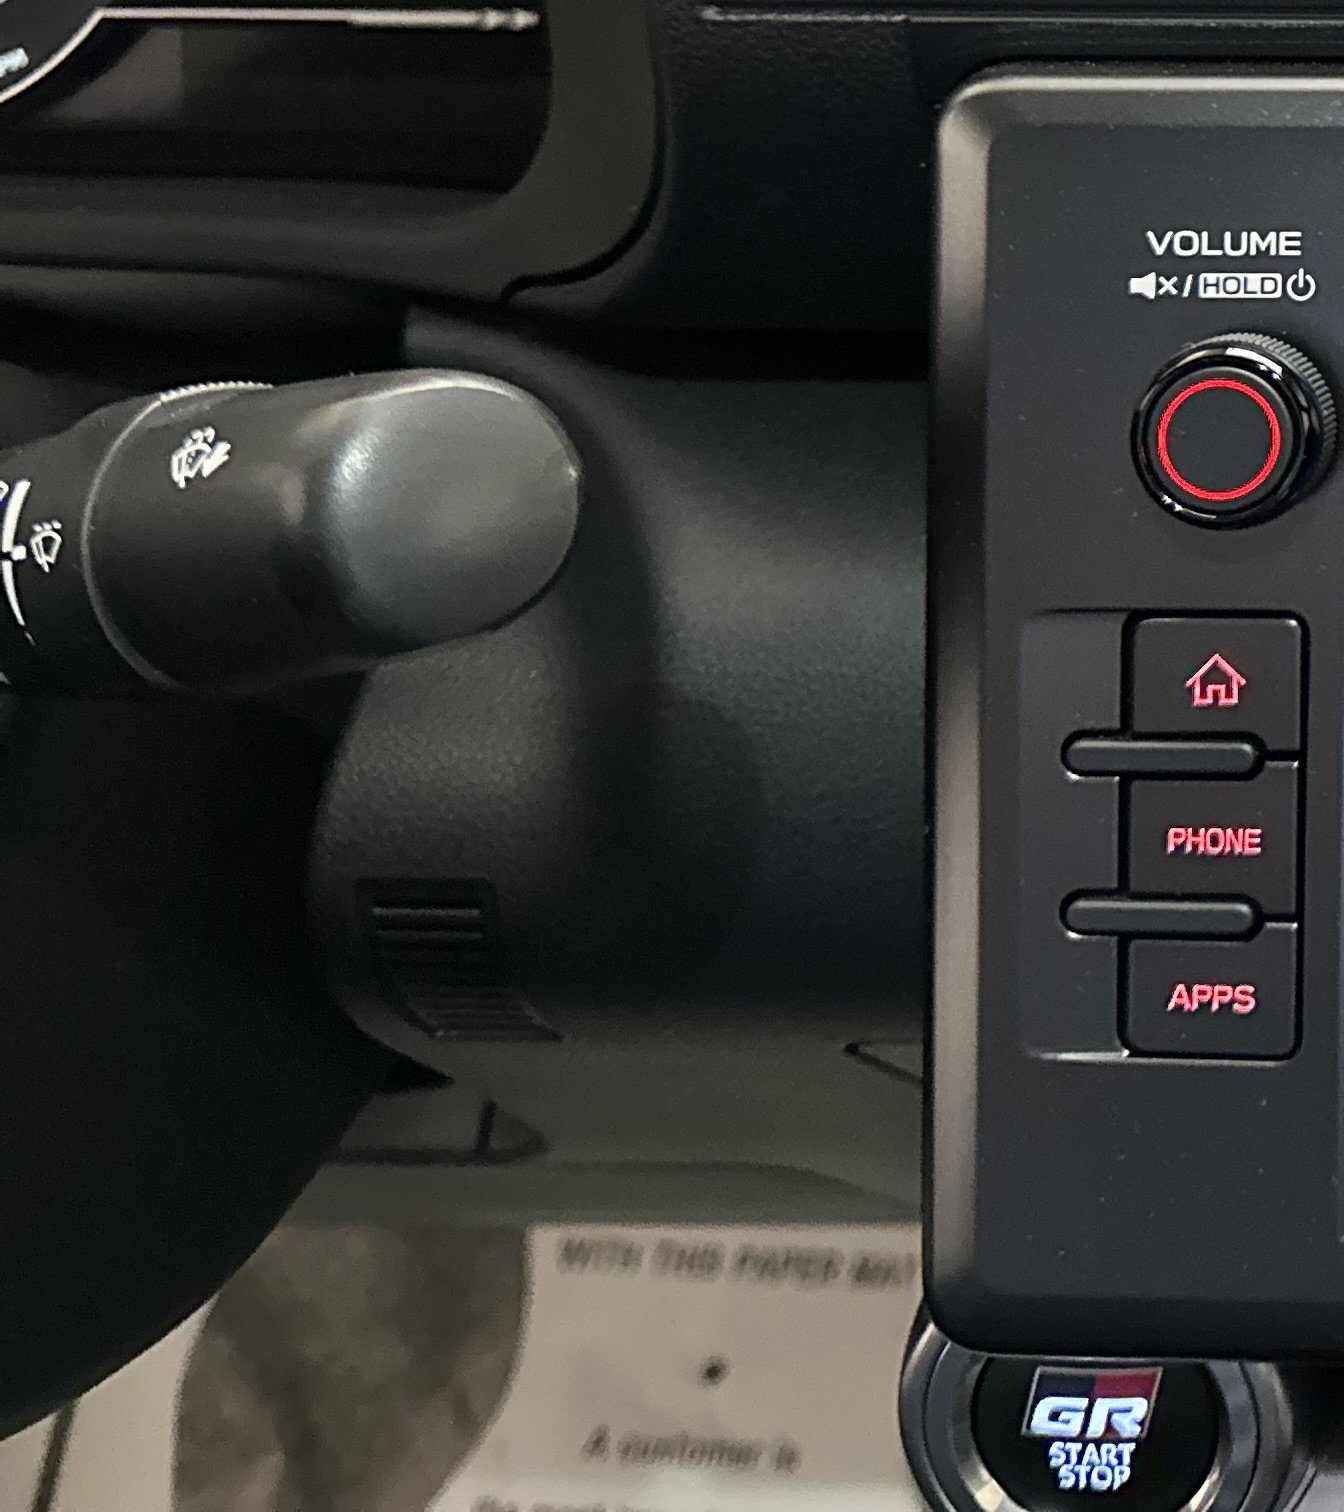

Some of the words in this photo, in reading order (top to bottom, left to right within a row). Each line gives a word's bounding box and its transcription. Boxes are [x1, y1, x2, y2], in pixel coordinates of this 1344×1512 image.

[1146, 230, 1303, 257] VOLUME
[1202, 275, 1280, 296] HOLD
[1167, 826, 1262, 856] PHONE
[1167, 983, 1256, 1014] APPS
[1030, 1396, 1150, 1438] GR
[1049, 1442, 1136, 1469] START
[1058, 1464, 1131, 1492] STOP
